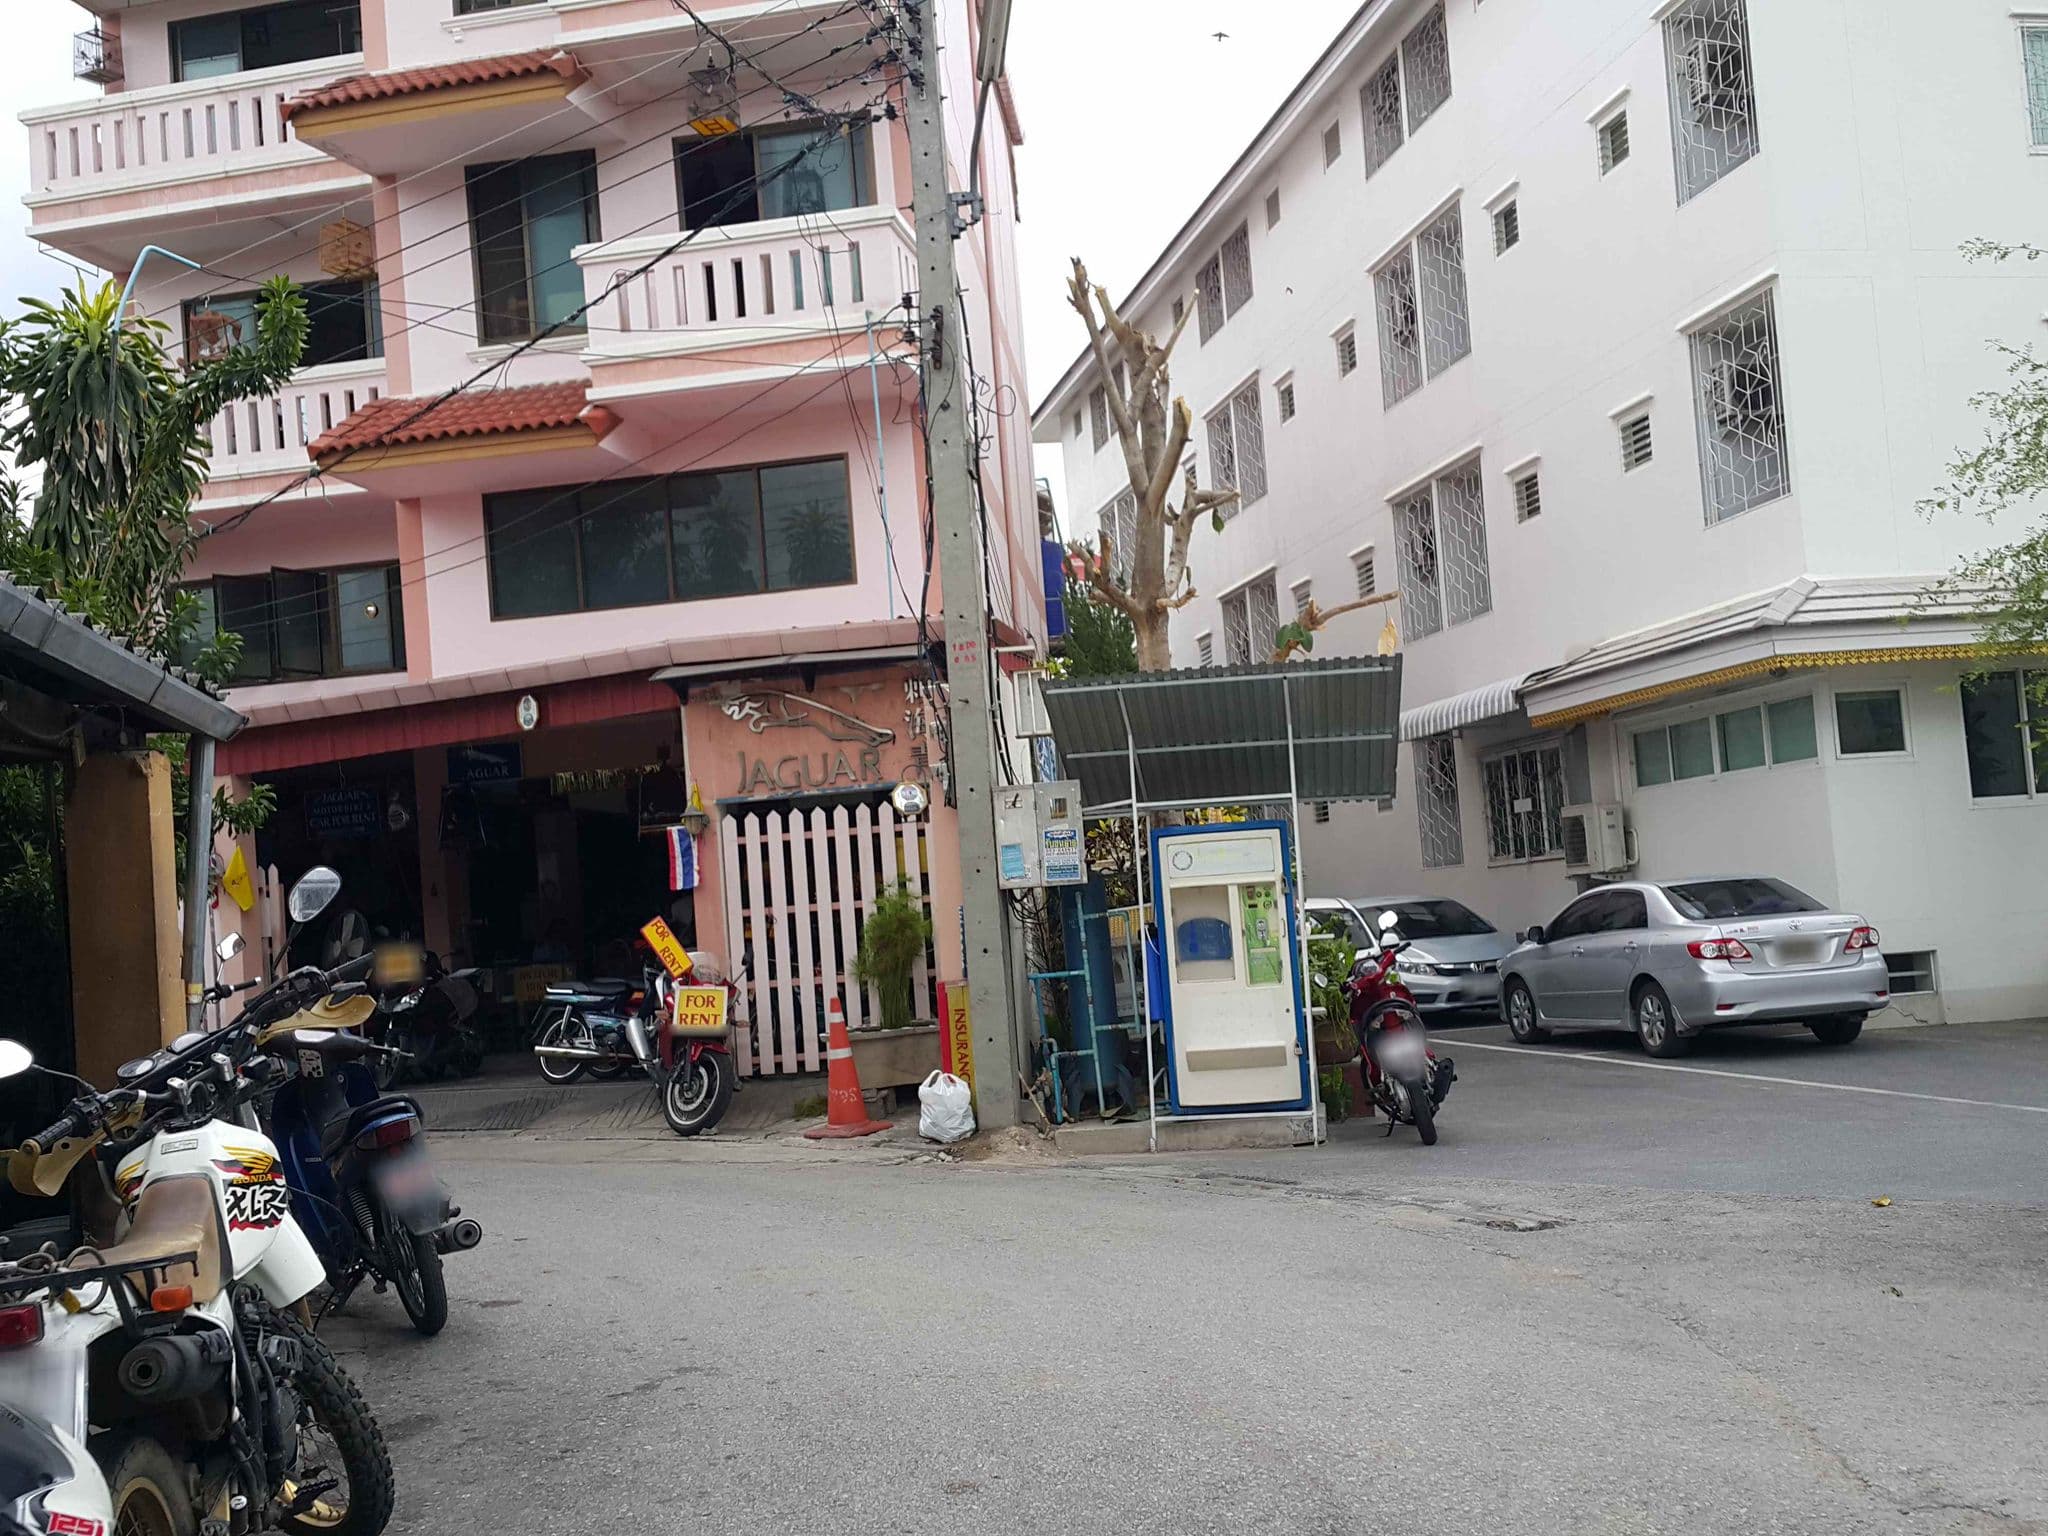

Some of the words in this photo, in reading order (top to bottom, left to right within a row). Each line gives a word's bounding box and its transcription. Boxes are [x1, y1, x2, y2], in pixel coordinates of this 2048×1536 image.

[737, 747, 883, 793] JAGUAR
[651, 919, 670, 942] FOR
[660, 945, 683, 973] RENT
[685, 995, 716, 1008] FOR
[680, 1013, 721, 1025] RENT
[954, 1008, 971, 1089] INSURANC
[232, 1173, 273, 1185] HONDA
[225, 1186, 288, 1221] XLR
